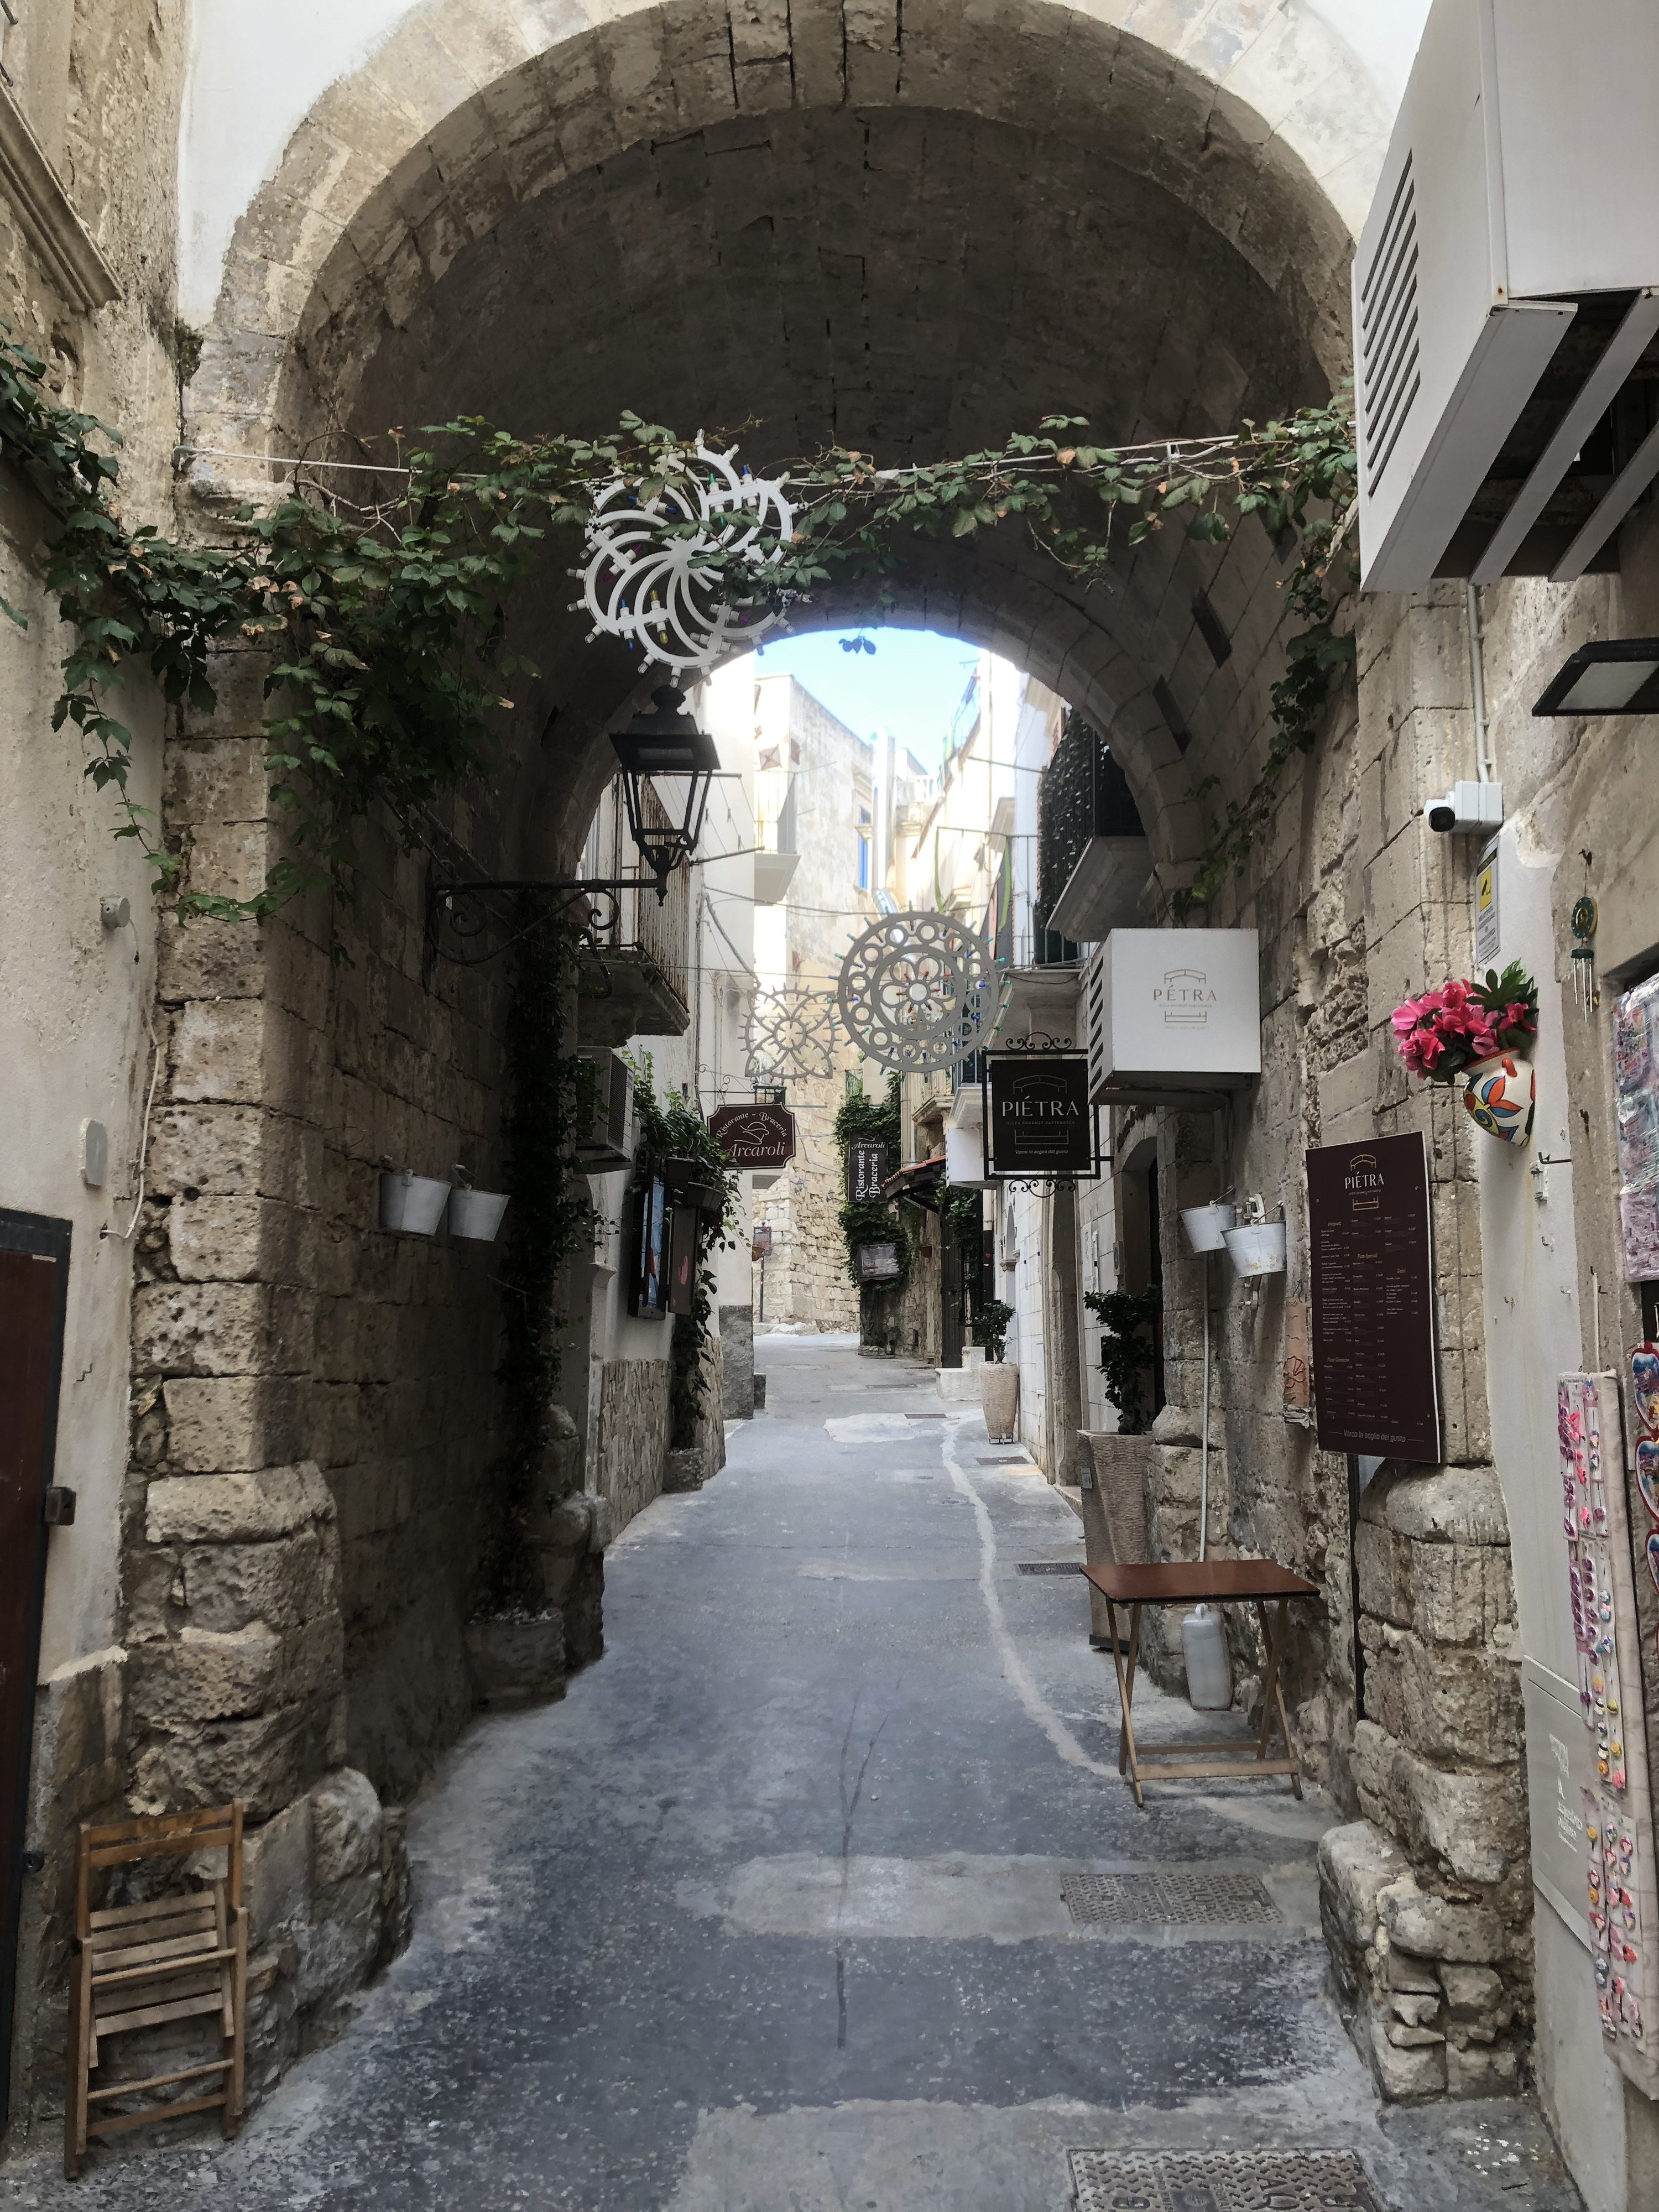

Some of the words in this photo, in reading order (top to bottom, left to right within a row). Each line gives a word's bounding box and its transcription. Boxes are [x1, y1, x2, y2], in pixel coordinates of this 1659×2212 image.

[1154, 984, 1217, 1001] PÉTRA
[1002, 1095, 1079, 1117] PIÉTRA
[716, 1113, 749, 1139] Ristorante
[759, 1112, 787, 1138] Braceria
[725, 1141, 786, 1157] Arcaroli
[855, 1150, 869, 1201] Ristorante
[869, 1153, 880, 1198] Braceria
[1345, 1171, 1384, 1190] PIÉTRA
